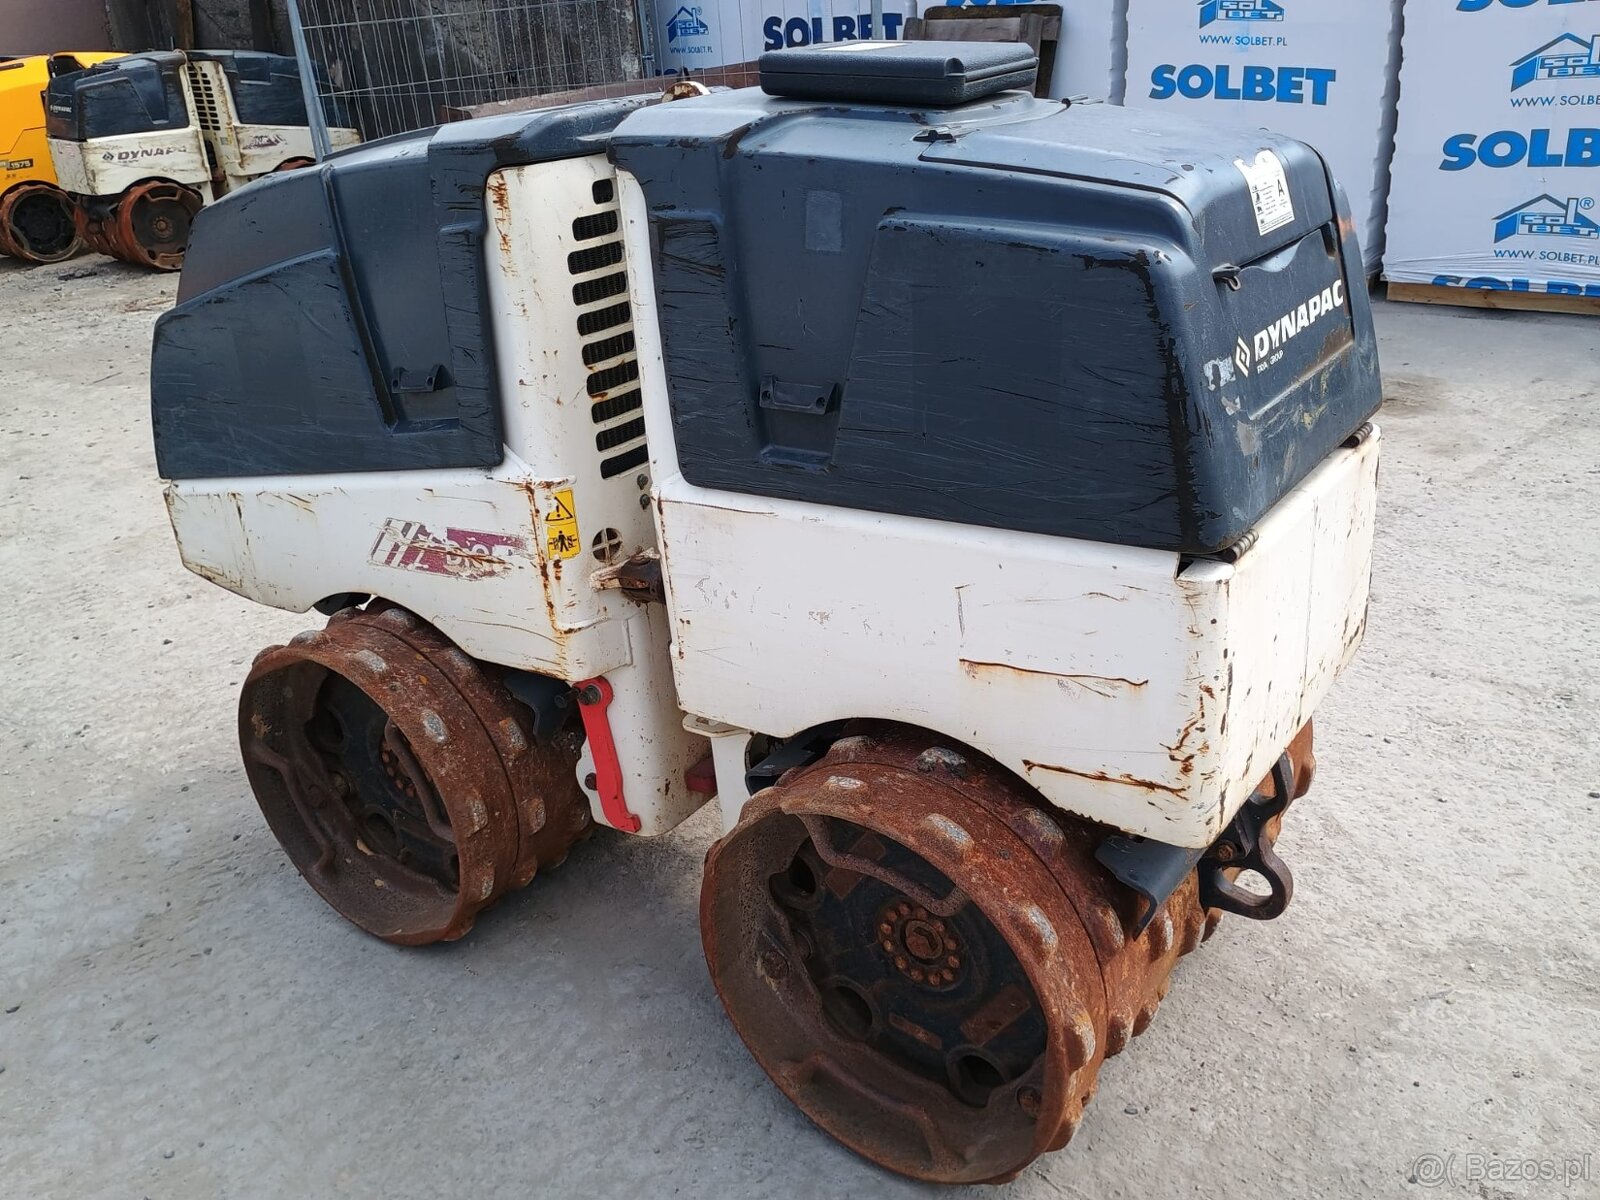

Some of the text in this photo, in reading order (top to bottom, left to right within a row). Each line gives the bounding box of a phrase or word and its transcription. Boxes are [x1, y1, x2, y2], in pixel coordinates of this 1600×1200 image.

[1199, 35, 1288, 46] WWW.SOLBET.PL
[1149, 63, 1337, 106] SOLBET
[1493, 249, 1600, 266] WWW.SOLBET.PL
[1253, 279, 1344, 362] DYNAPAC
